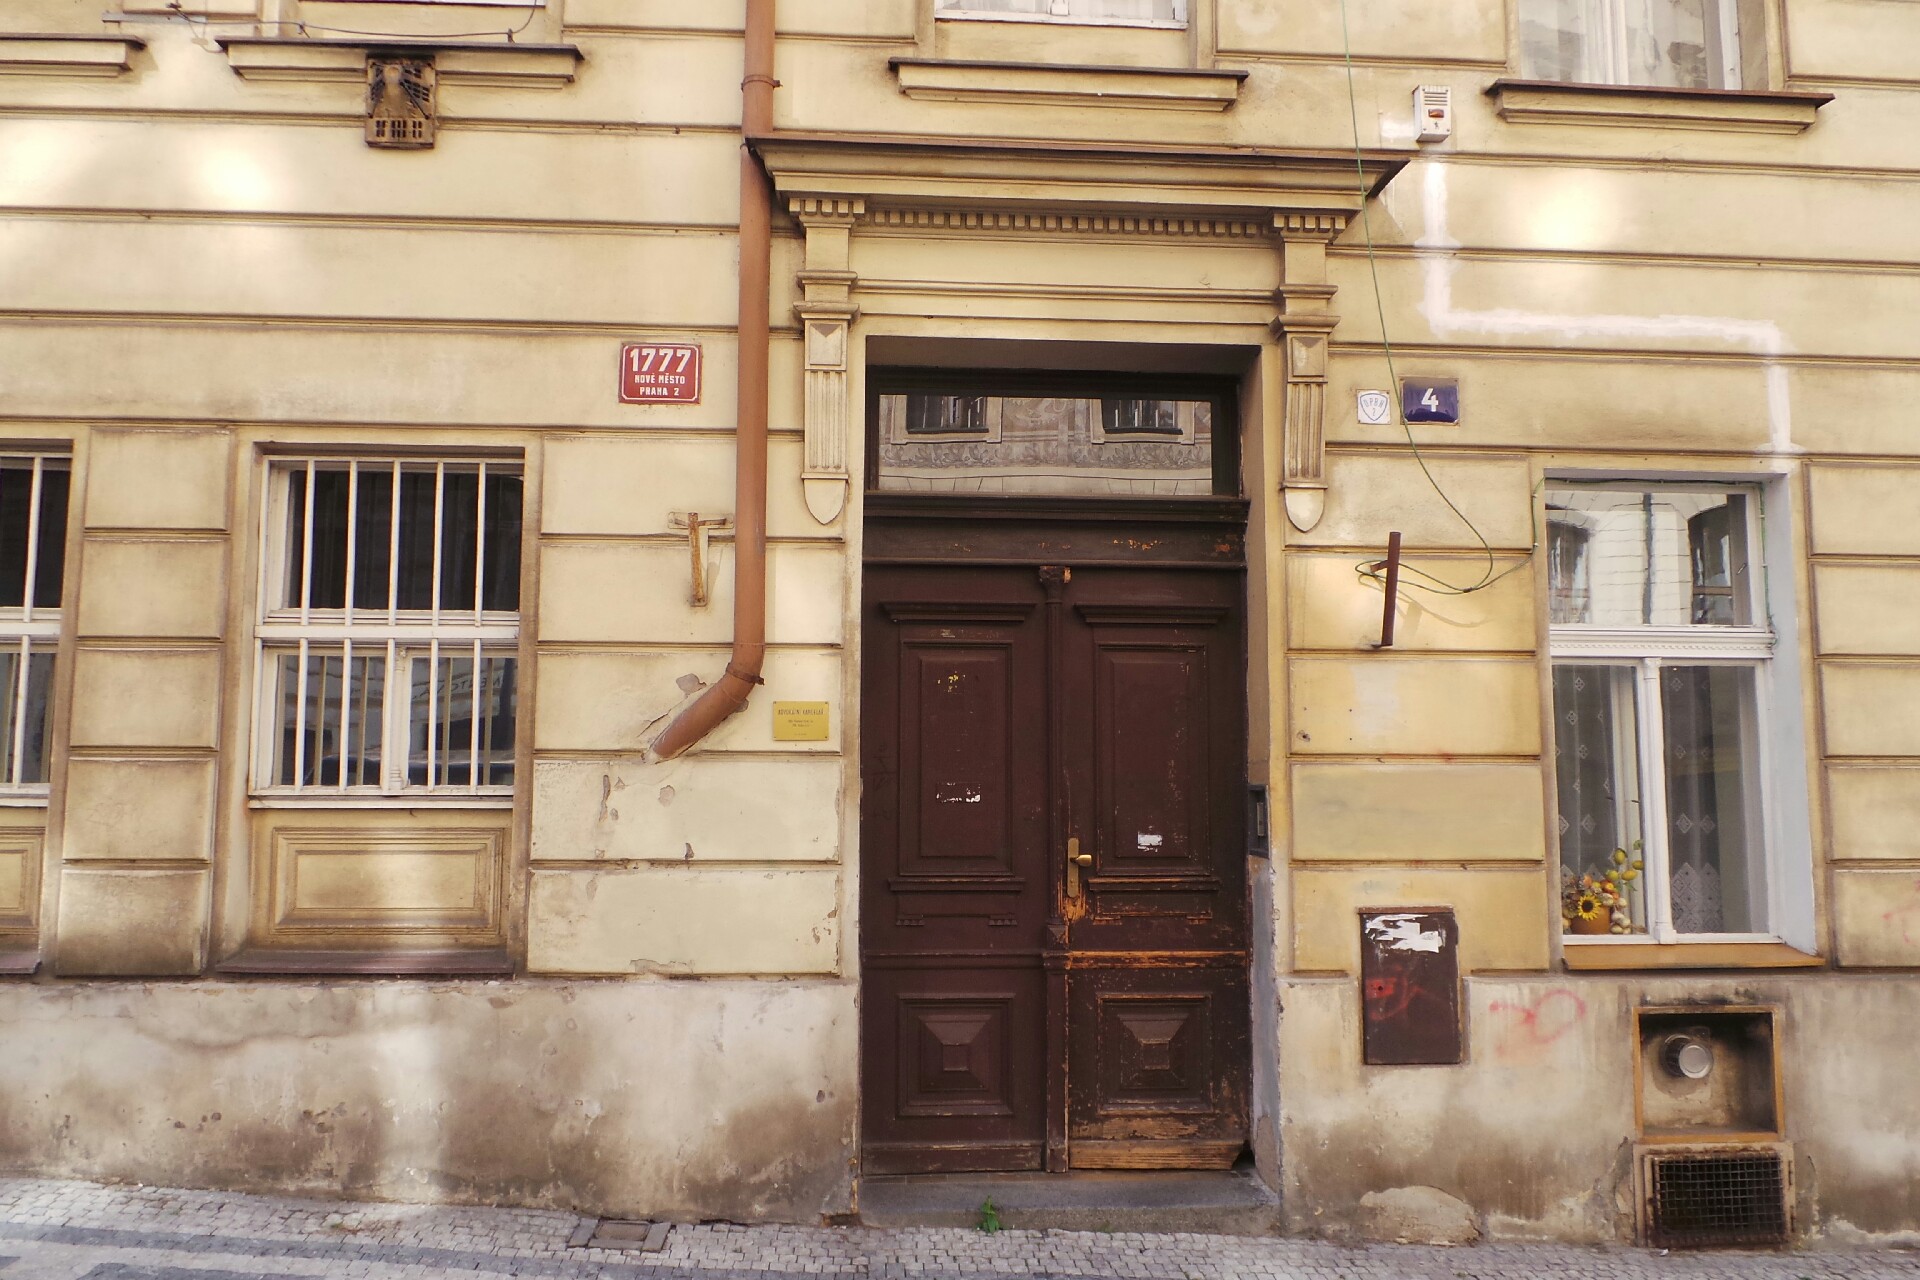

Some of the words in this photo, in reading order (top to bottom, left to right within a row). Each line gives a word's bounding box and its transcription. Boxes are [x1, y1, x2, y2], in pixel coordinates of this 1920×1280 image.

[630, 348, 692, 373] 1777
[634, 372, 656, 384] NOVÉ
[658, 372, 686, 385] MĚSTO
[639, 386, 668, 396] PRAHA
[673, 387, 680, 396] 2
[1420, 387, 1439, 412] 4
